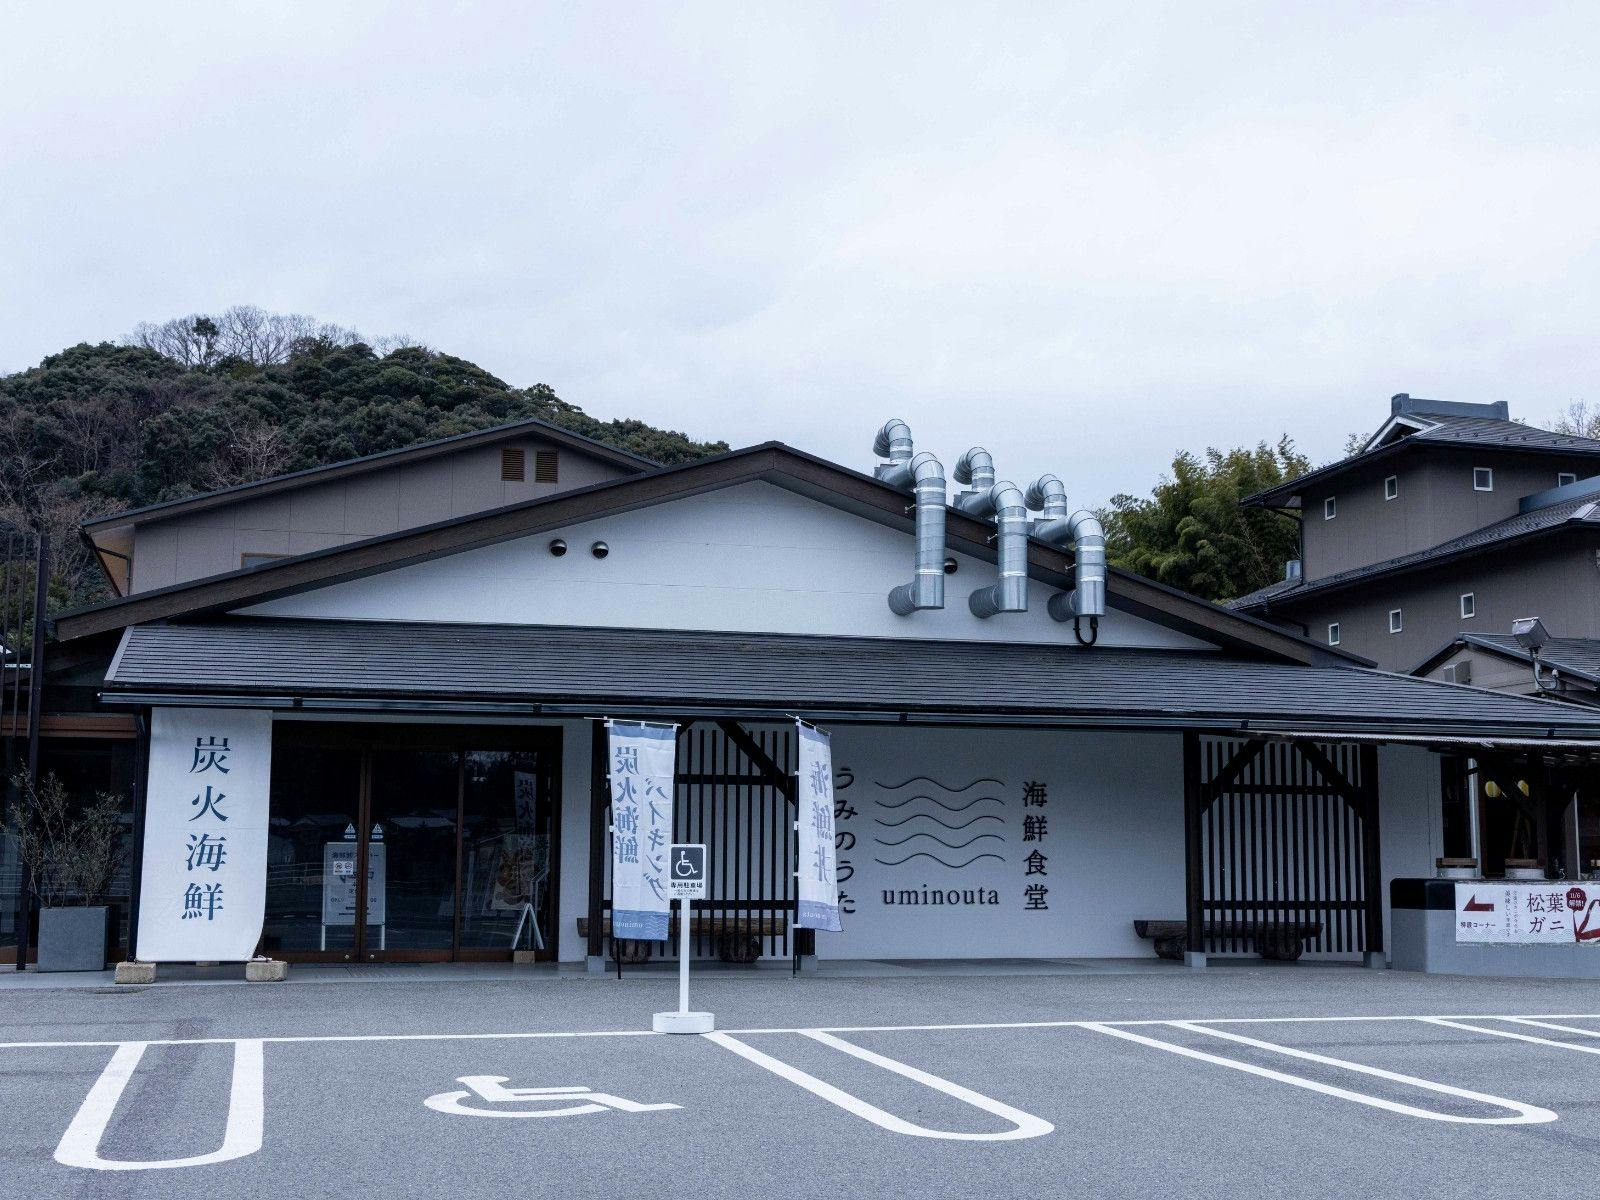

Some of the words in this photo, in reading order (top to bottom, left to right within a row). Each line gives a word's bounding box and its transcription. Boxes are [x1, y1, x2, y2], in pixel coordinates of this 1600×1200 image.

[181, 736, 231, 921] 炭火海鮮
[834, 767, 859, 914] うみのうた
[1023, 781, 1048, 910] 海鮮食堂
[882, 884, 999, 905] uminouta
[1527, 892, 1564, 913] 松葉
[1529, 917, 1565, 934] ガニ
